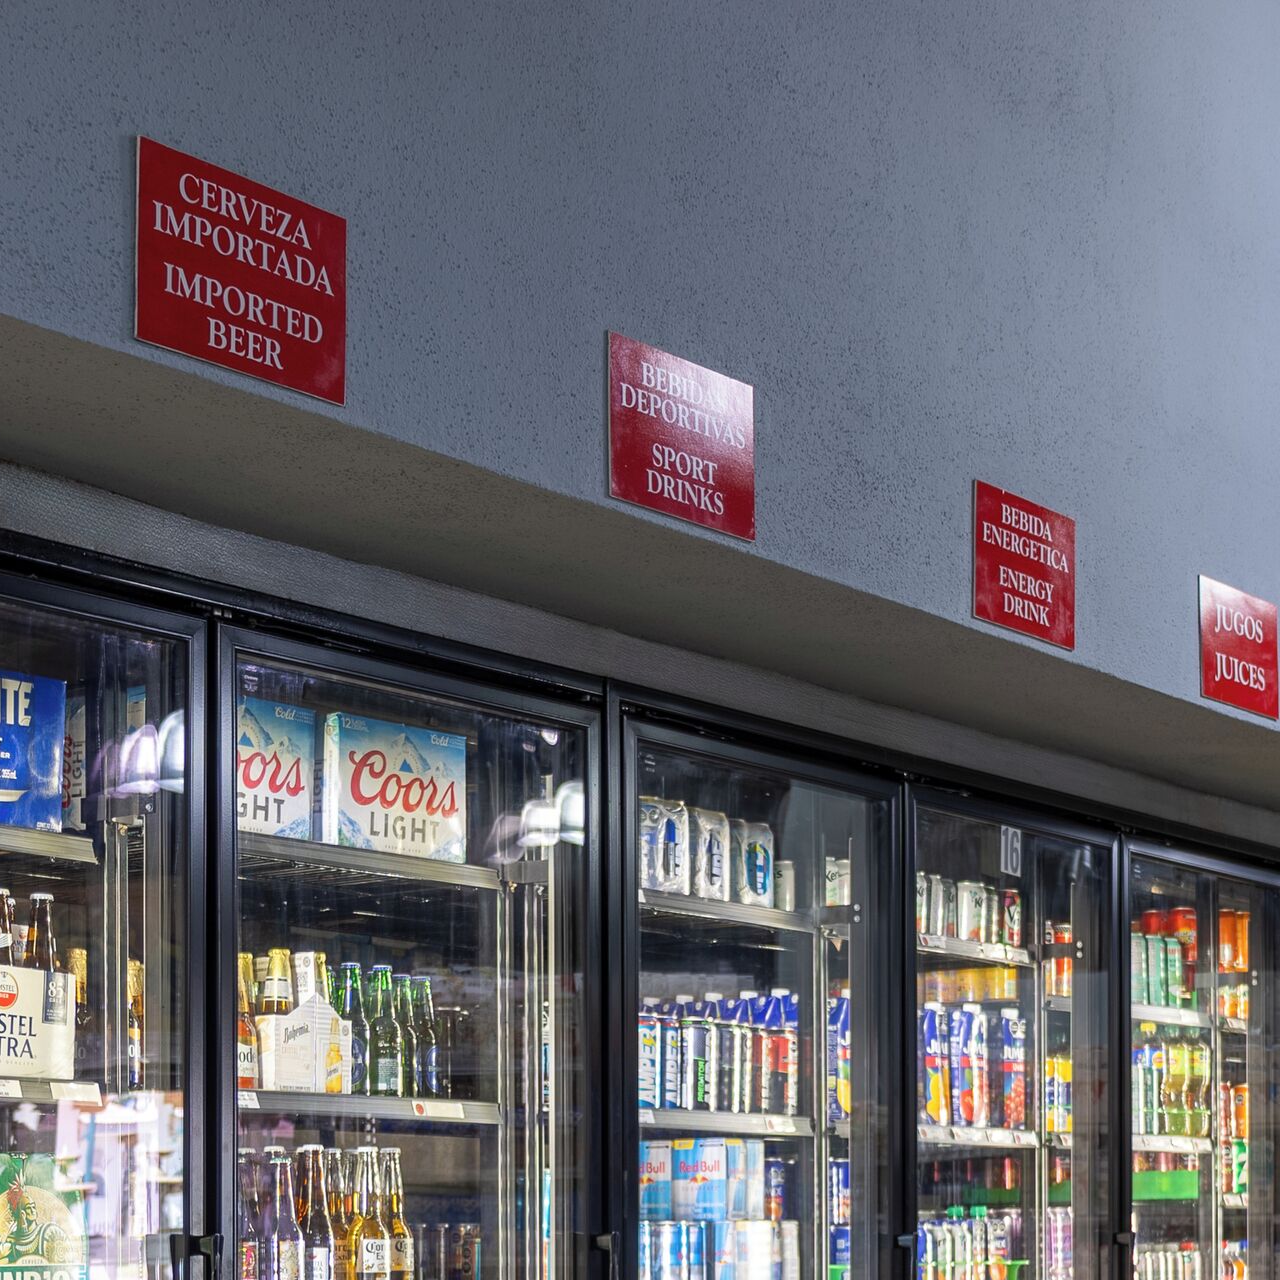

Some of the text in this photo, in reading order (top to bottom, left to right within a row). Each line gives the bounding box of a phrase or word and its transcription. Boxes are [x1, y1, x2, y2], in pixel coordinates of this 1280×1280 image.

[179, 173, 312, 249] CERVEZA
[153, 200, 334, 296] IMPORTADA
[164, 262, 322, 343] IMPORTED
[207, 317, 283, 369] BEER
[620, 383, 745, 449] DEPORTIVAS
[652, 442, 717, 486] SPORT
[647, 468, 724, 516] DRINKS
[1001, 503, 1052, 542] BEBIDA
[983, 521, 1069, 573] ENERGETICA
[999, 565, 1054, 603] ENERGY
[1003, 592, 1050, 627] DRINK
[1215, 604, 1263, 643] JUGOS
[1215, 652, 1265, 691] JUICES
[348, 750, 458, 818] Coors
[369, 811, 440, 844] LIGHT
[679, 1159, 720, 1173] Red Bull
